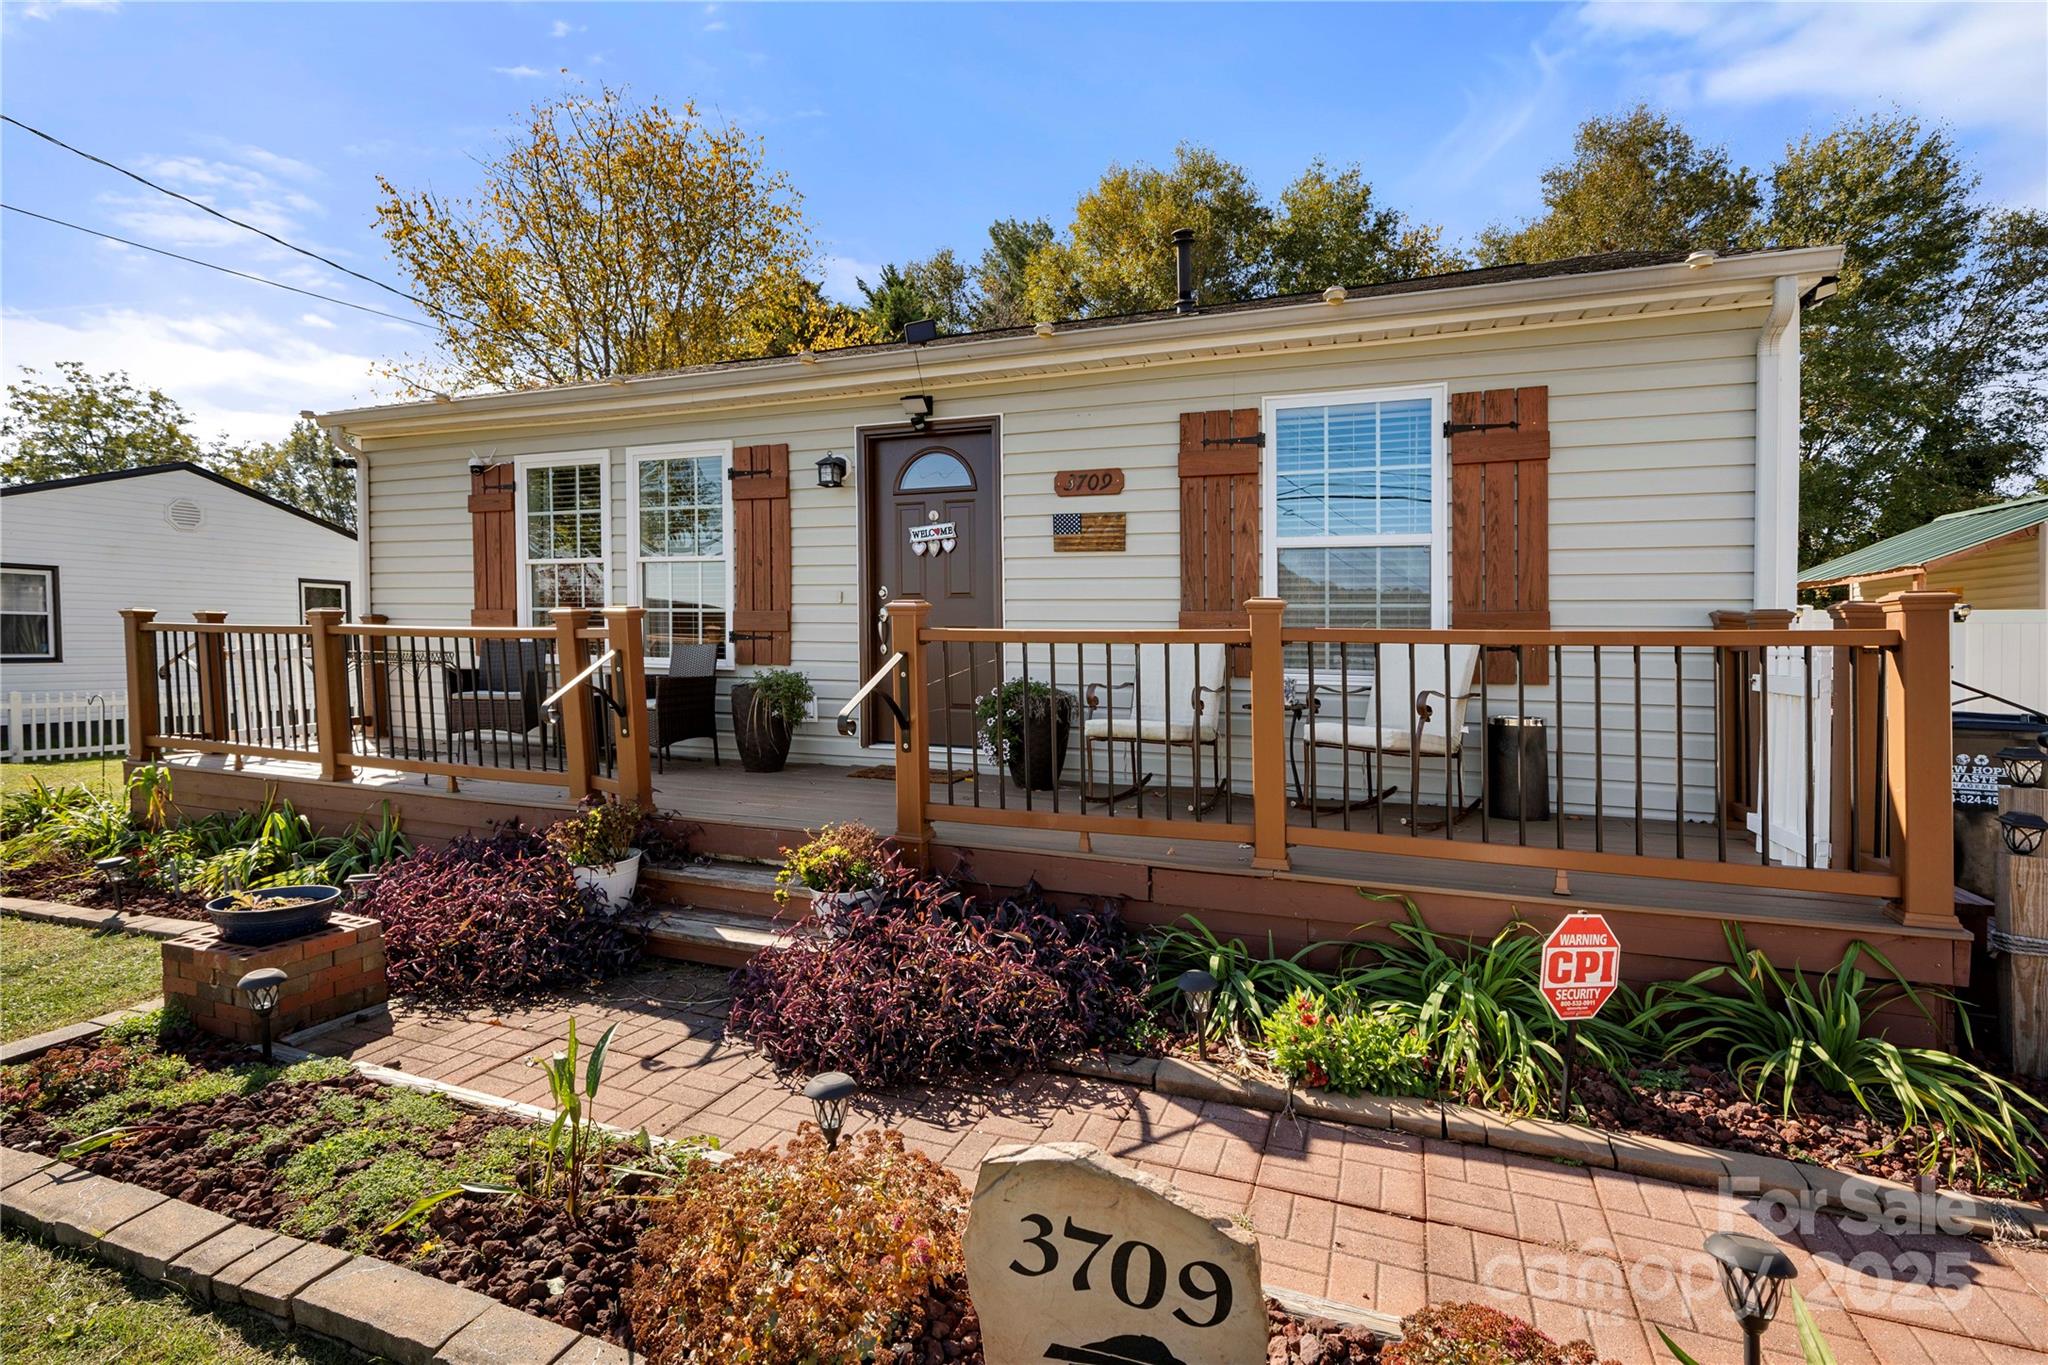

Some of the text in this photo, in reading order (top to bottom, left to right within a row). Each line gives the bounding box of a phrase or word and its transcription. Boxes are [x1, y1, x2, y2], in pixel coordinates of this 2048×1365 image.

[1063, 472, 1113, 491] 3709
[1560, 934, 1607, 945] WARNING
[1548, 951, 1615, 984] CPI
[1556, 988, 1601, 1000] SECURITY
[1009, 1213, 1233, 1328] 3709
